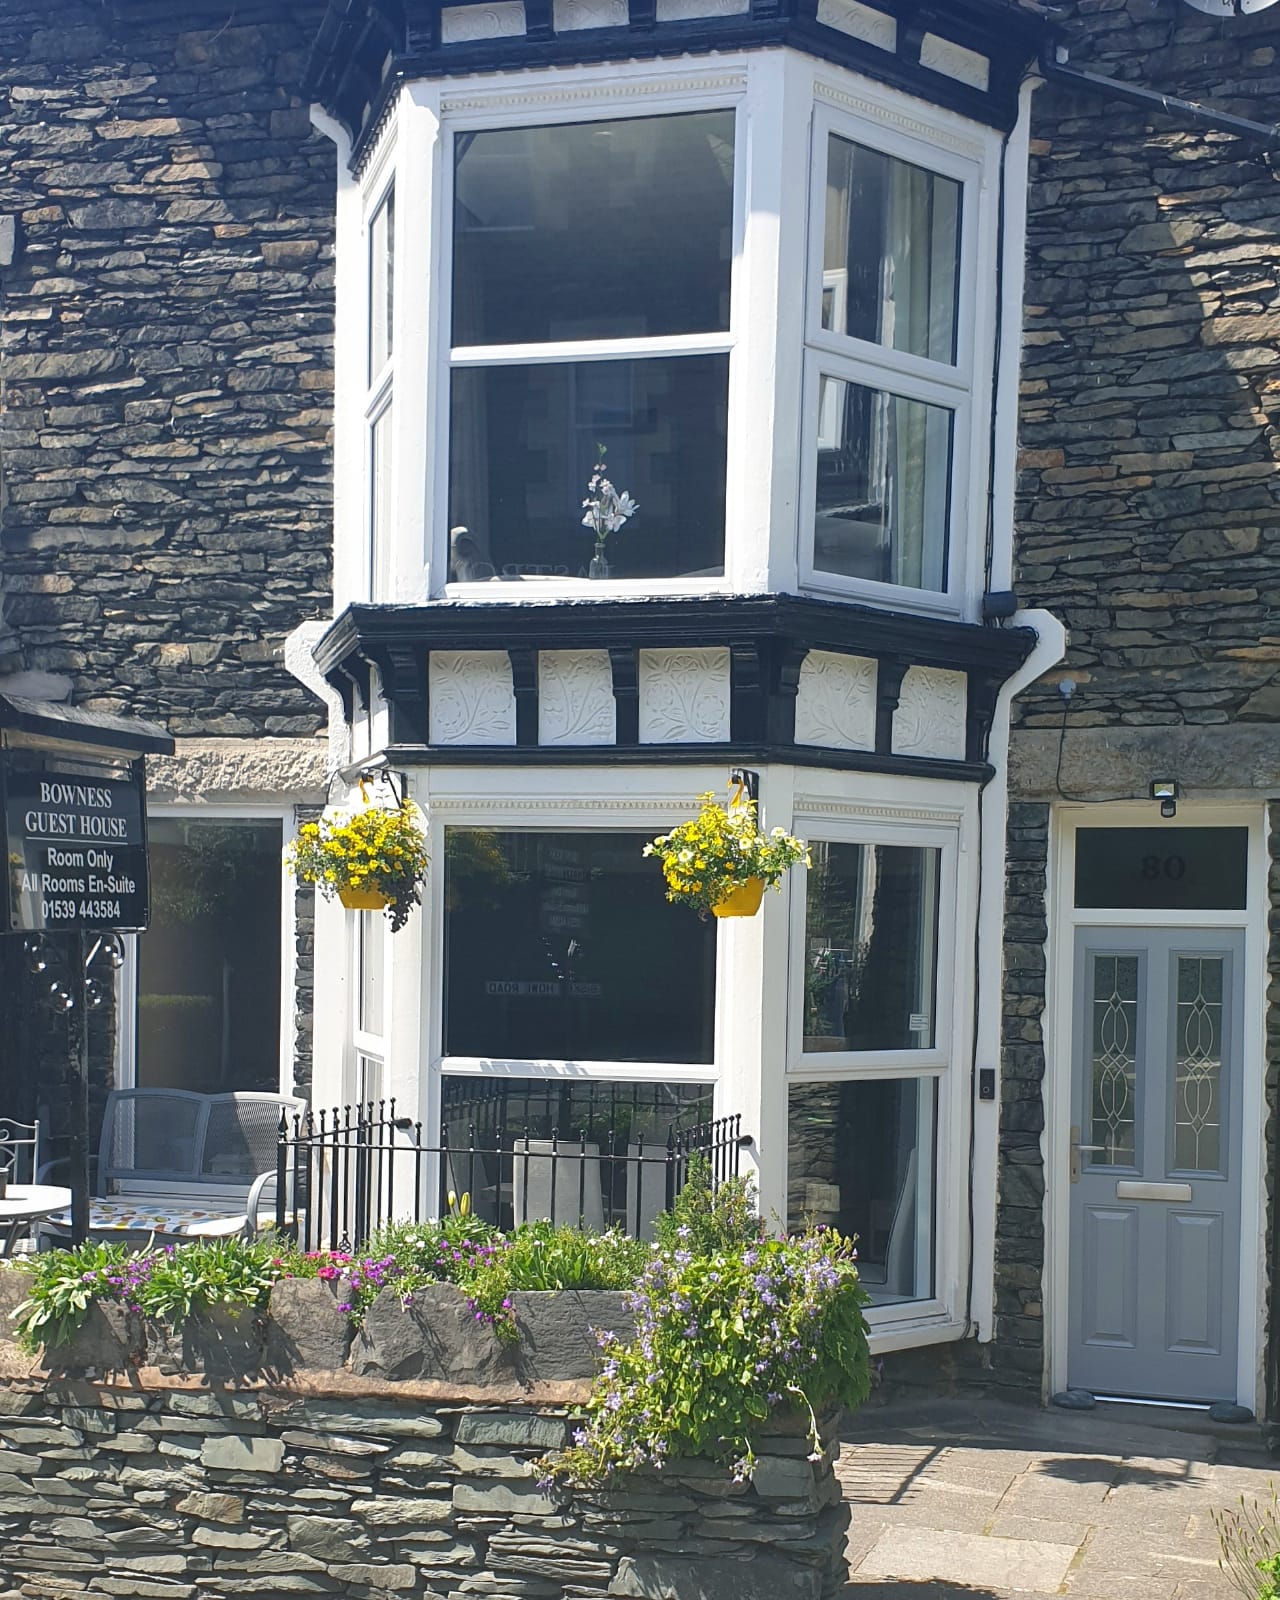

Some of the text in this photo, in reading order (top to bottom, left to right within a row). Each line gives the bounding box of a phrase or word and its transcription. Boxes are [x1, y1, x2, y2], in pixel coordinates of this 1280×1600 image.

[40, 782, 112, 808] BOWNESS
[25, 811, 127, 837] GUEST HOUSE
[48, 847, 113, 872] Room Only
[1142, 855, 1186, 880] 80
[22, 874, 136, 893] All Rooms En-Suite
[42, 900, 121, 919] 01539 443584
